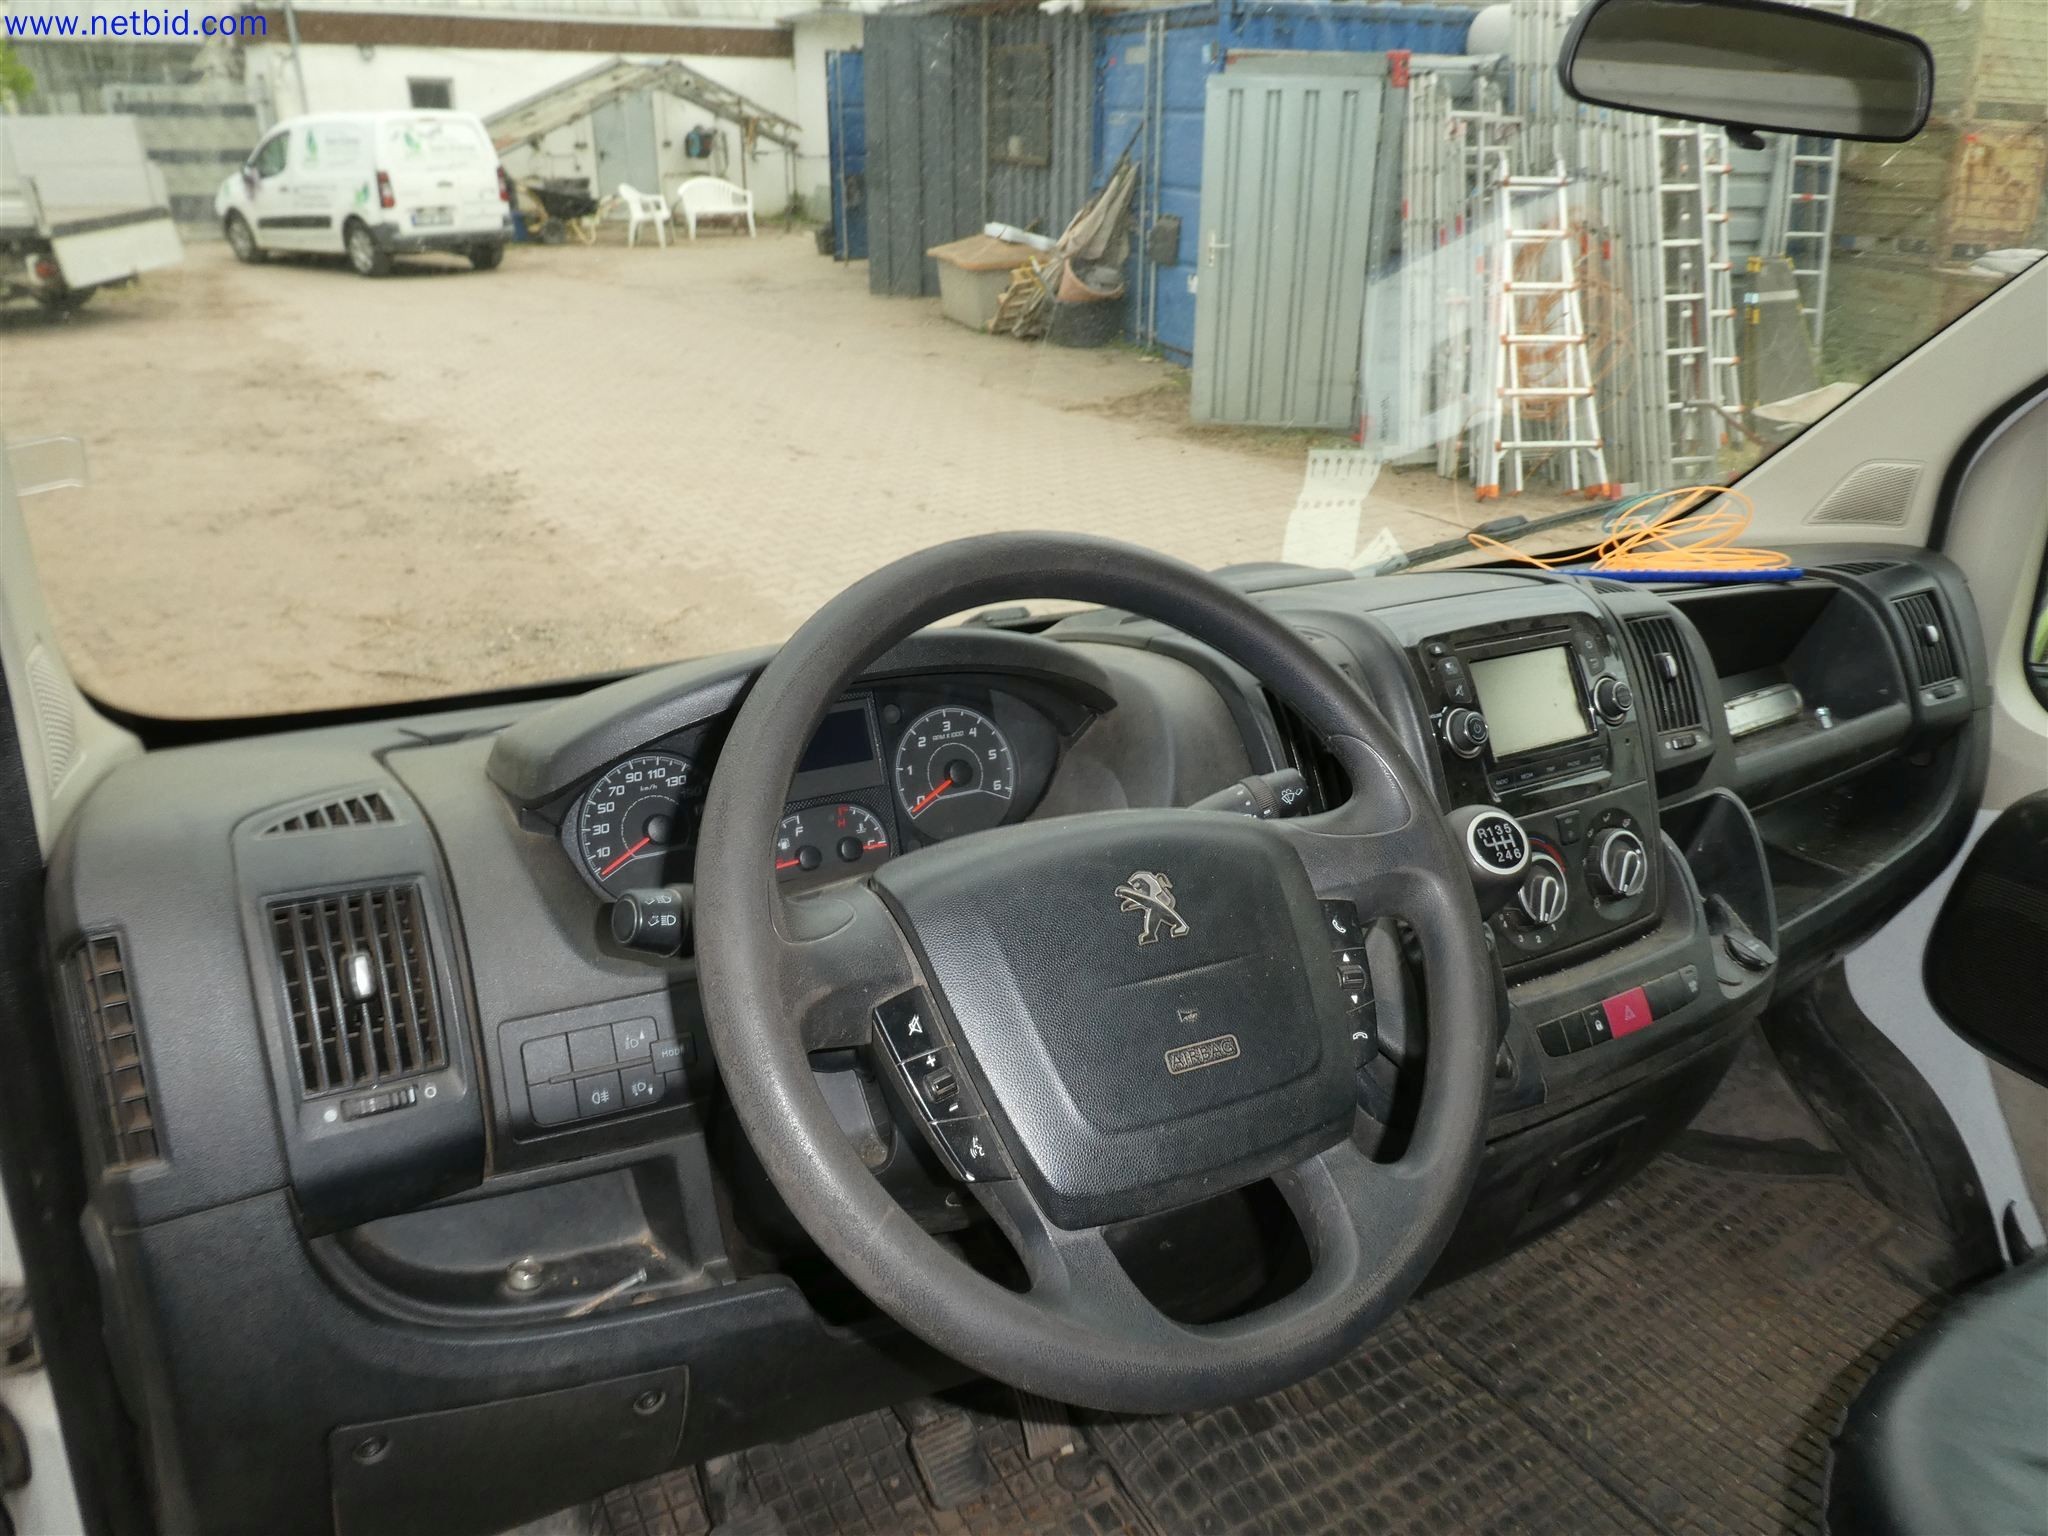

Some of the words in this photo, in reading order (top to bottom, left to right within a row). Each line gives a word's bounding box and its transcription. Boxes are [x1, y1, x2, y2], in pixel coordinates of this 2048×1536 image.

[942, 721, 951, 732] 3
[969, 727, 977, 737] 4
[918, 737, 926, 748] 2
[988, 749, 997, 760] 5
[647, 768, 666, 779] 110
[907, 765, 913, 775] 1
[625, 771, 642, 783] 90
[665, 775, 687, 788] 130
[993, 780, 1002, 790] 6
[608, 785, 625, 797] 70
[597, 802, 615, 814] 50
[592, 823, 610, 835] 30
[795, 826, 804, 837] F
[596, 847, 611, 858] 10
[1171, 1040, 1236, 1070] AIRBAG
